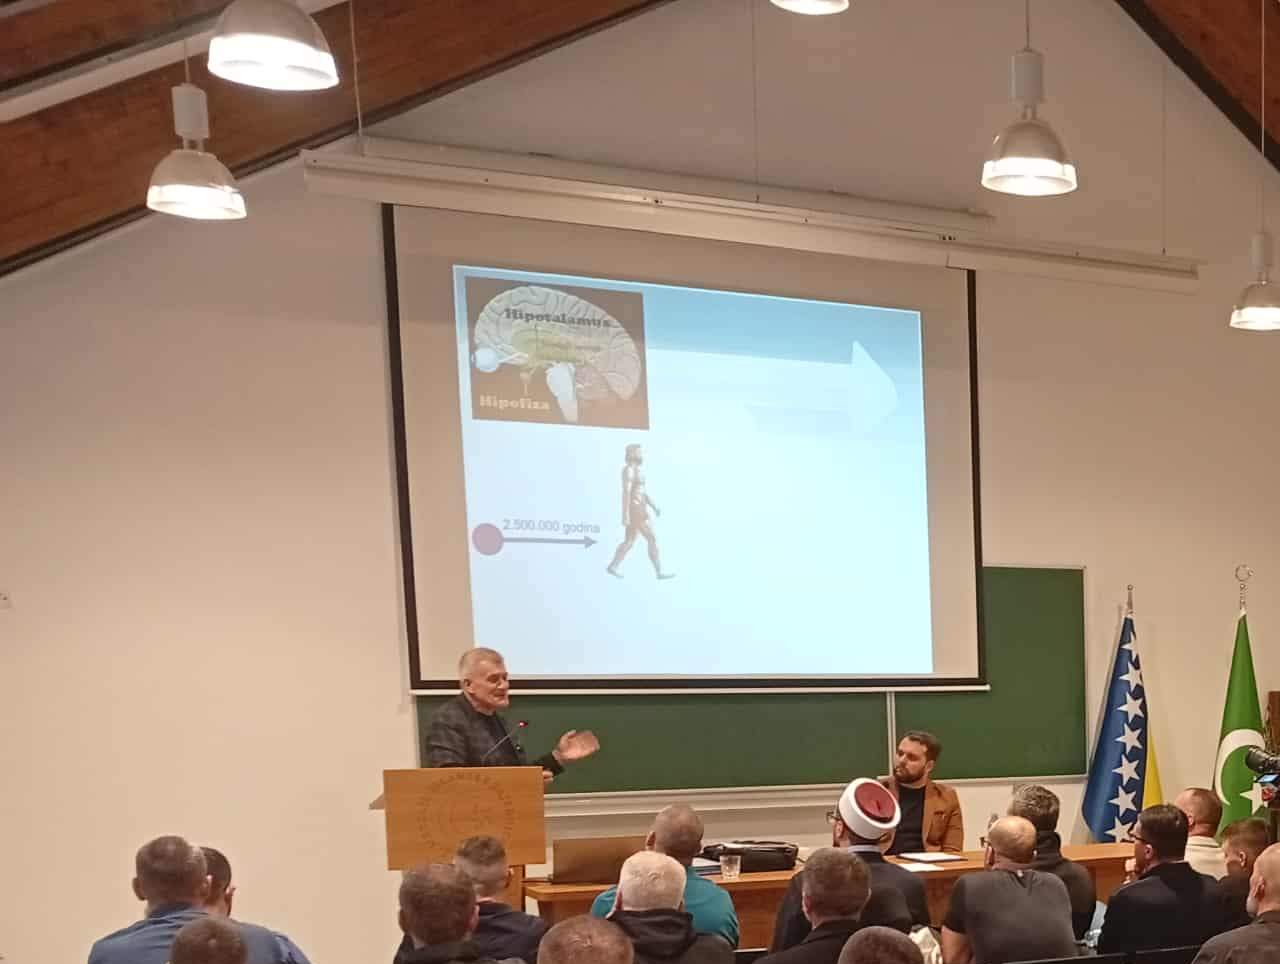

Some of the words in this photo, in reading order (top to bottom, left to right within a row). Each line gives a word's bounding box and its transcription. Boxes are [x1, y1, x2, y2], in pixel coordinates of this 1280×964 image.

[504, 308, 612, 328] Hipotalamus
[479, 395, 550, 411] Hipofiza
[503, 518, 560, 532] 2.500.000
[562, 520, 600, 535] godina
